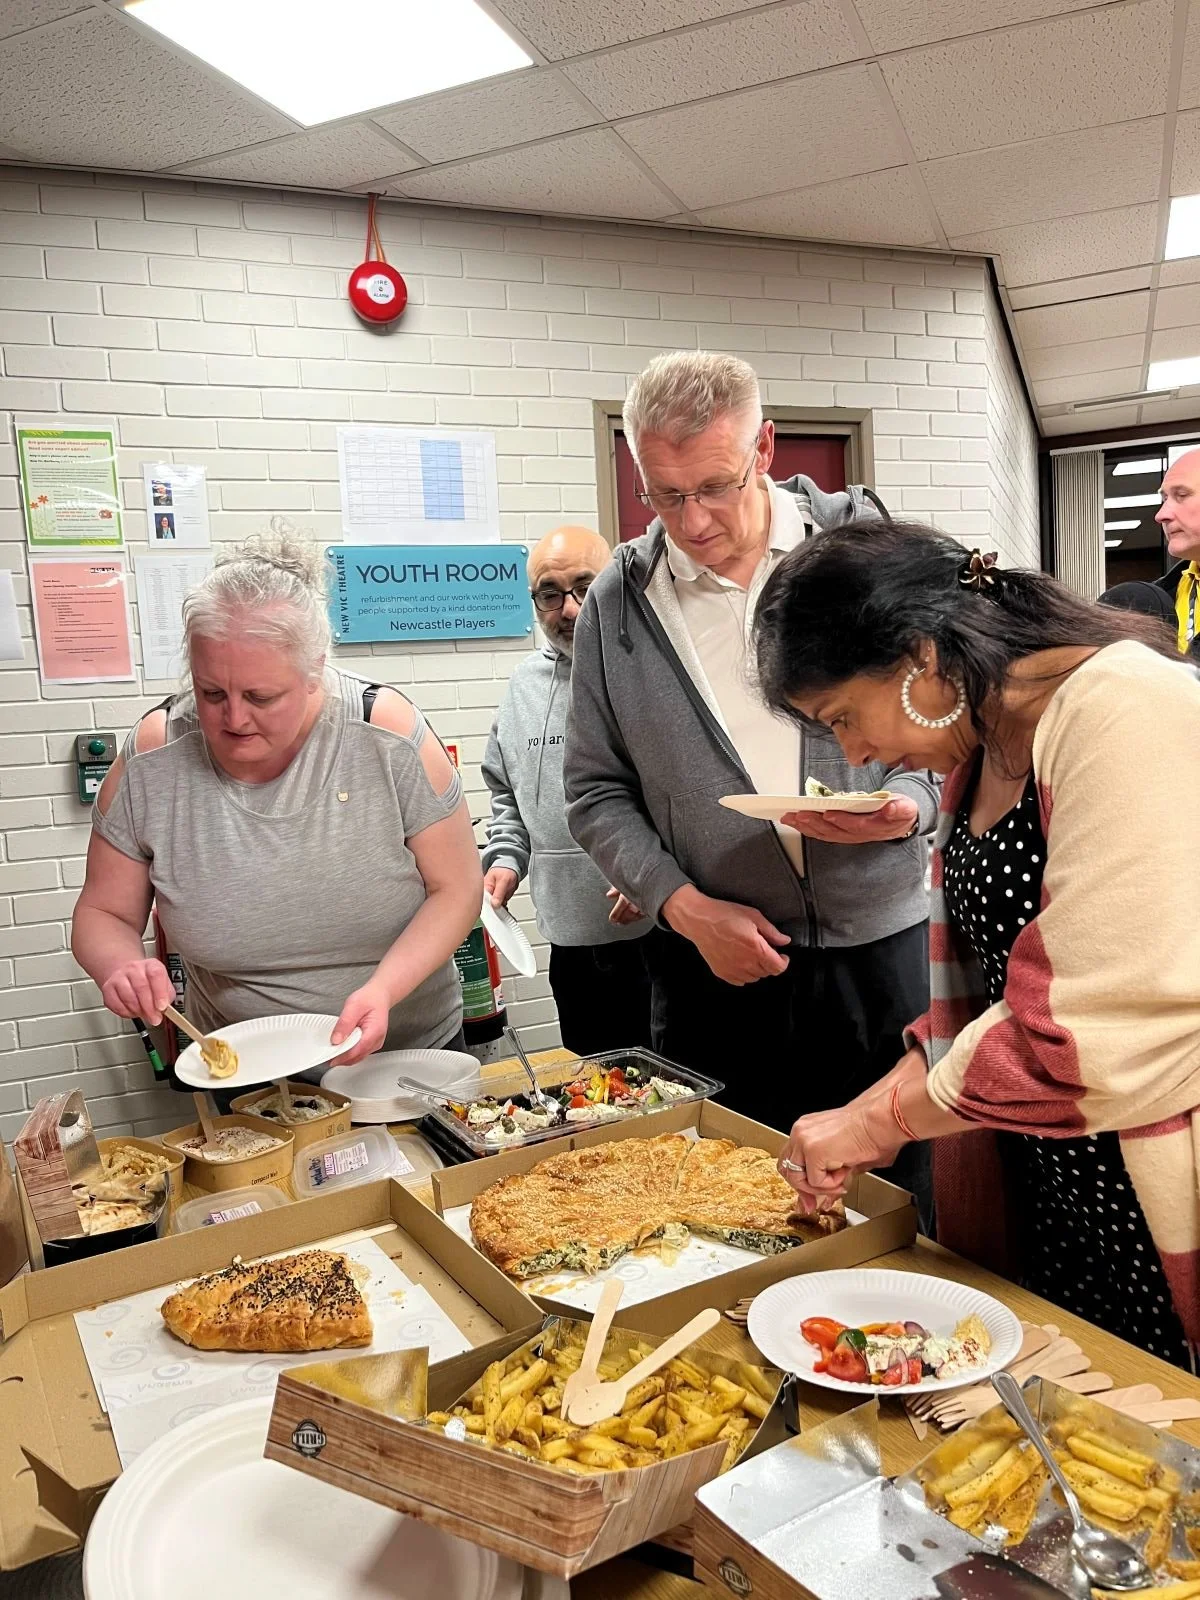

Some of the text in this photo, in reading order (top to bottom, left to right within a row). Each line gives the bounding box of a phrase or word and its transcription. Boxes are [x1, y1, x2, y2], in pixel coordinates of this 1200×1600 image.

[356, 563, 518, 584] YOUTH ROOM
[336, 554, 350, 634] NEW VIC THEATRE
[361, 594, 418, 604] refurbishment
[420, 594, 435, 602] and
[451, 593, 470, 601] work
[472, 593, 489, 601] with
[490, 593, 514, 602] young
[358, 606, 386, 616] people
[388, 605, 428, 614] supported
[430, 604, 440, 614] by
[448, 604, 465, 612] kind
[466, 603, 501, 612] donation
[502, 603, 521, 611] from
[390, 618, 496, 631] Newcastle Players
[293, 1431, 326, 1446] GRILL
